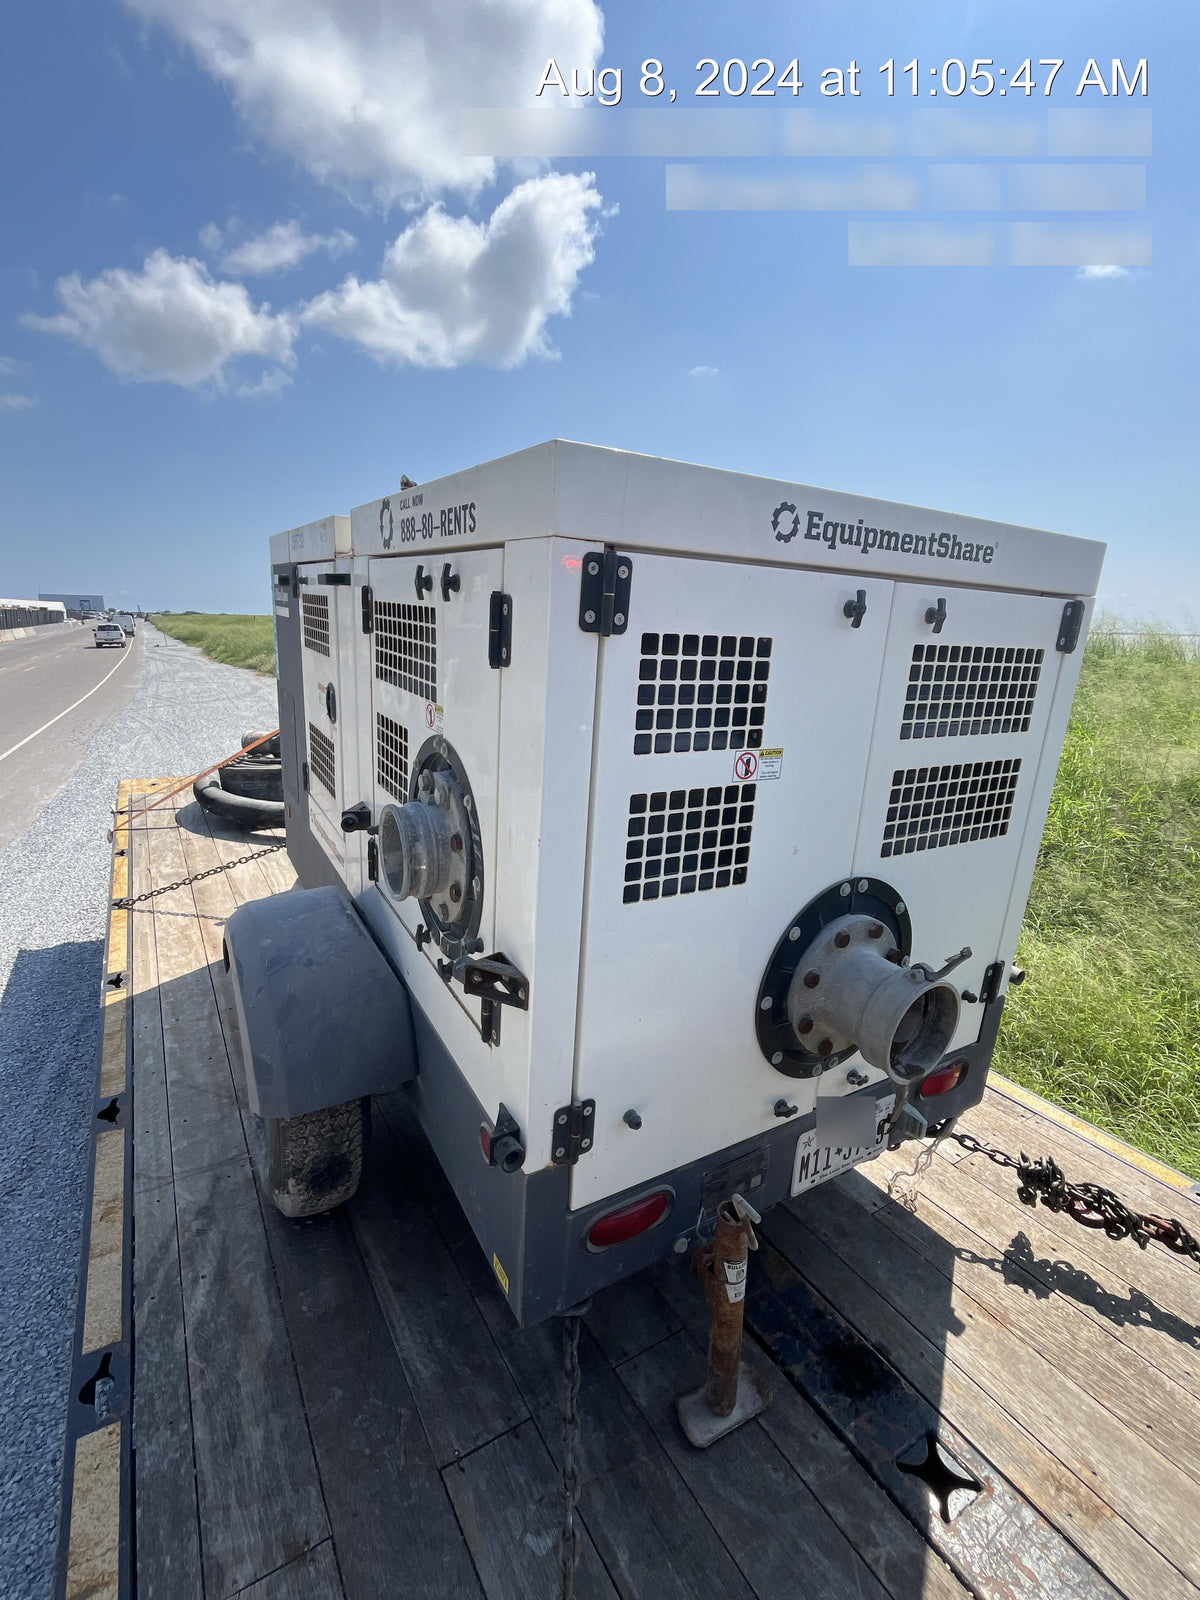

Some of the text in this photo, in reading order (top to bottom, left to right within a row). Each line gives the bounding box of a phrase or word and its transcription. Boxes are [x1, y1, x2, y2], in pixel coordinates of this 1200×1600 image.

[400, 494, 424, 510] CALL NOW
[401, 502, 476, 543] 888-80-RENTS
[804, 511, 994, 563] EquipmentShare
